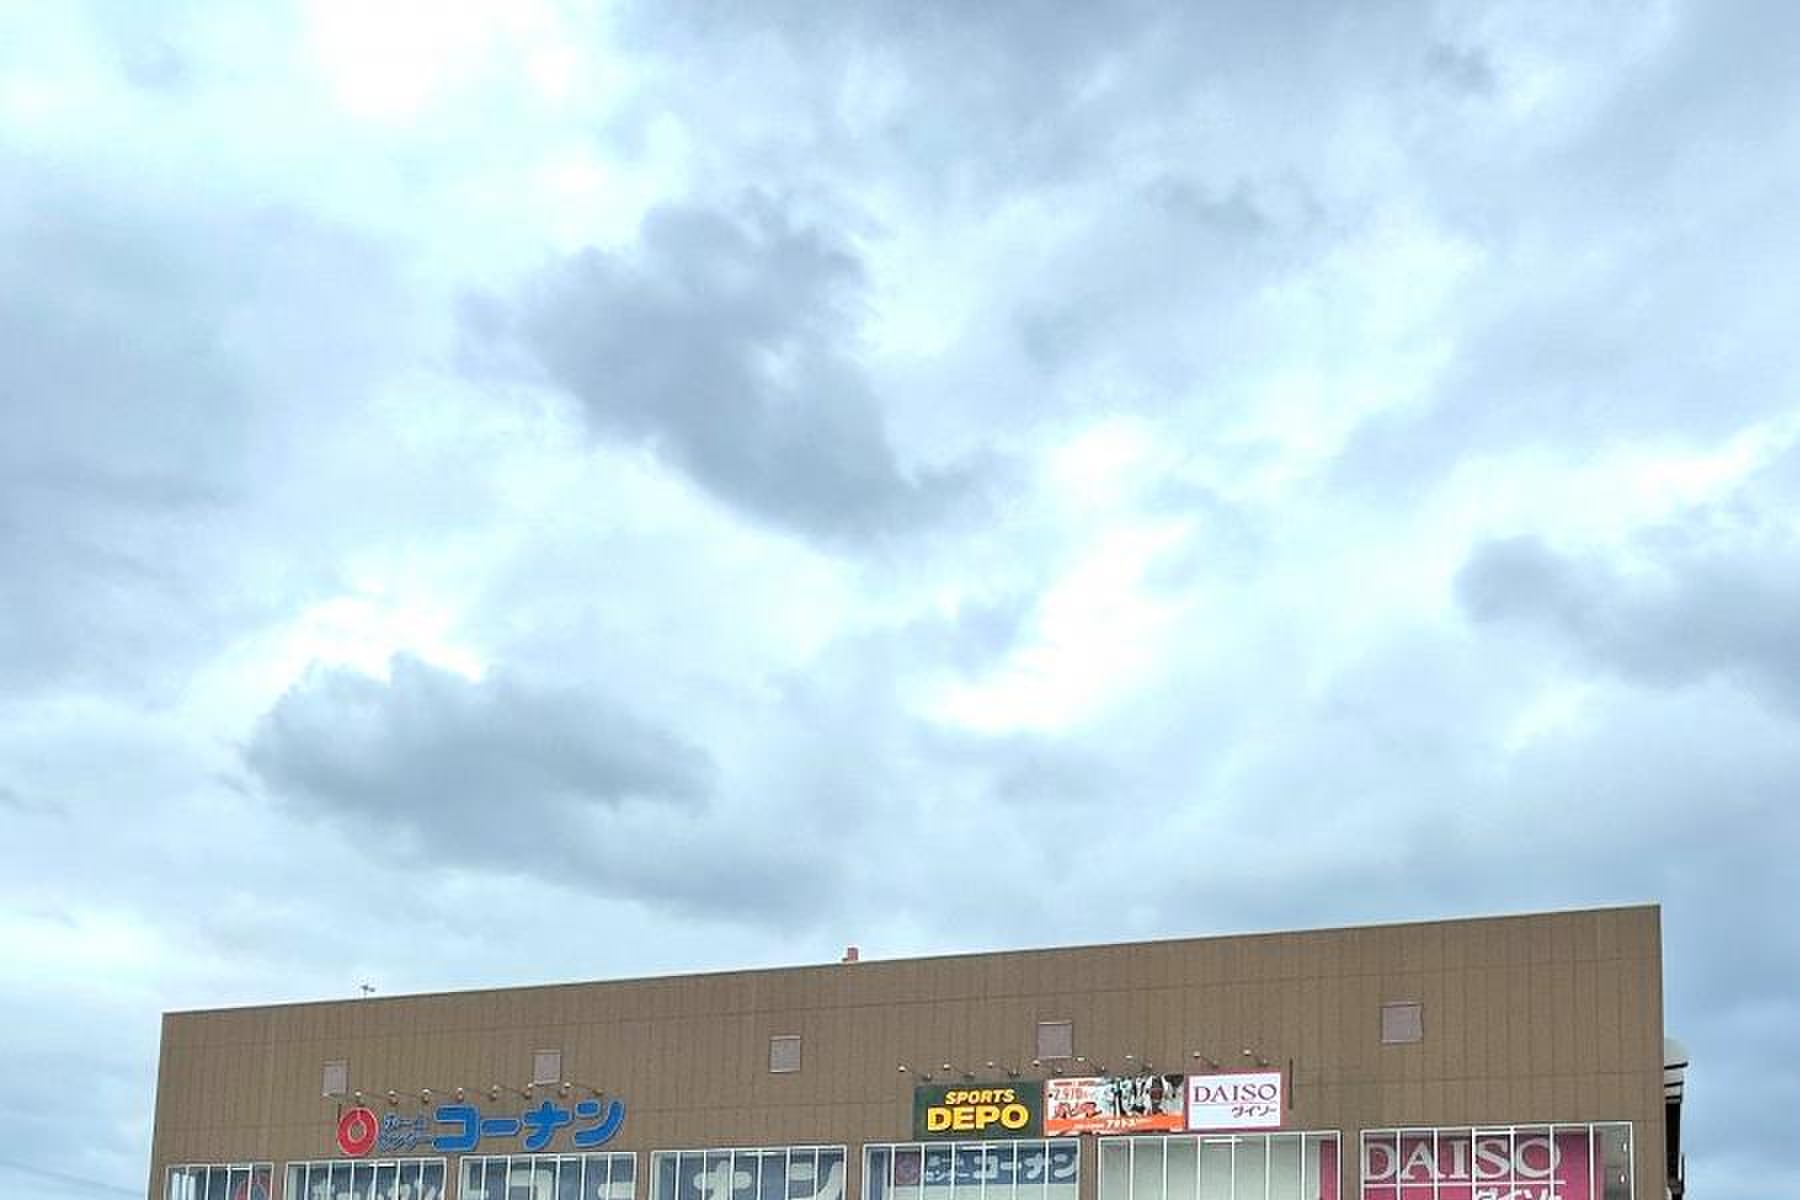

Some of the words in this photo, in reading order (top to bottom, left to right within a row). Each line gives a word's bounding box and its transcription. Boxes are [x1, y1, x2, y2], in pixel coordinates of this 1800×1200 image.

[945, 1087, 1015, 1105] SPORTS
[1193, 1083, 1278, 1102] DAISO
[432, 1098, 626, 1152] コーナン
[927, 1103, 1029, 1131] DEPO
[1231, 1104, 1278, 1119] ダイソー
[972, 1151, 1077, 1181] コーナン
[1362, 1136, 1562, 1181] DAISO
